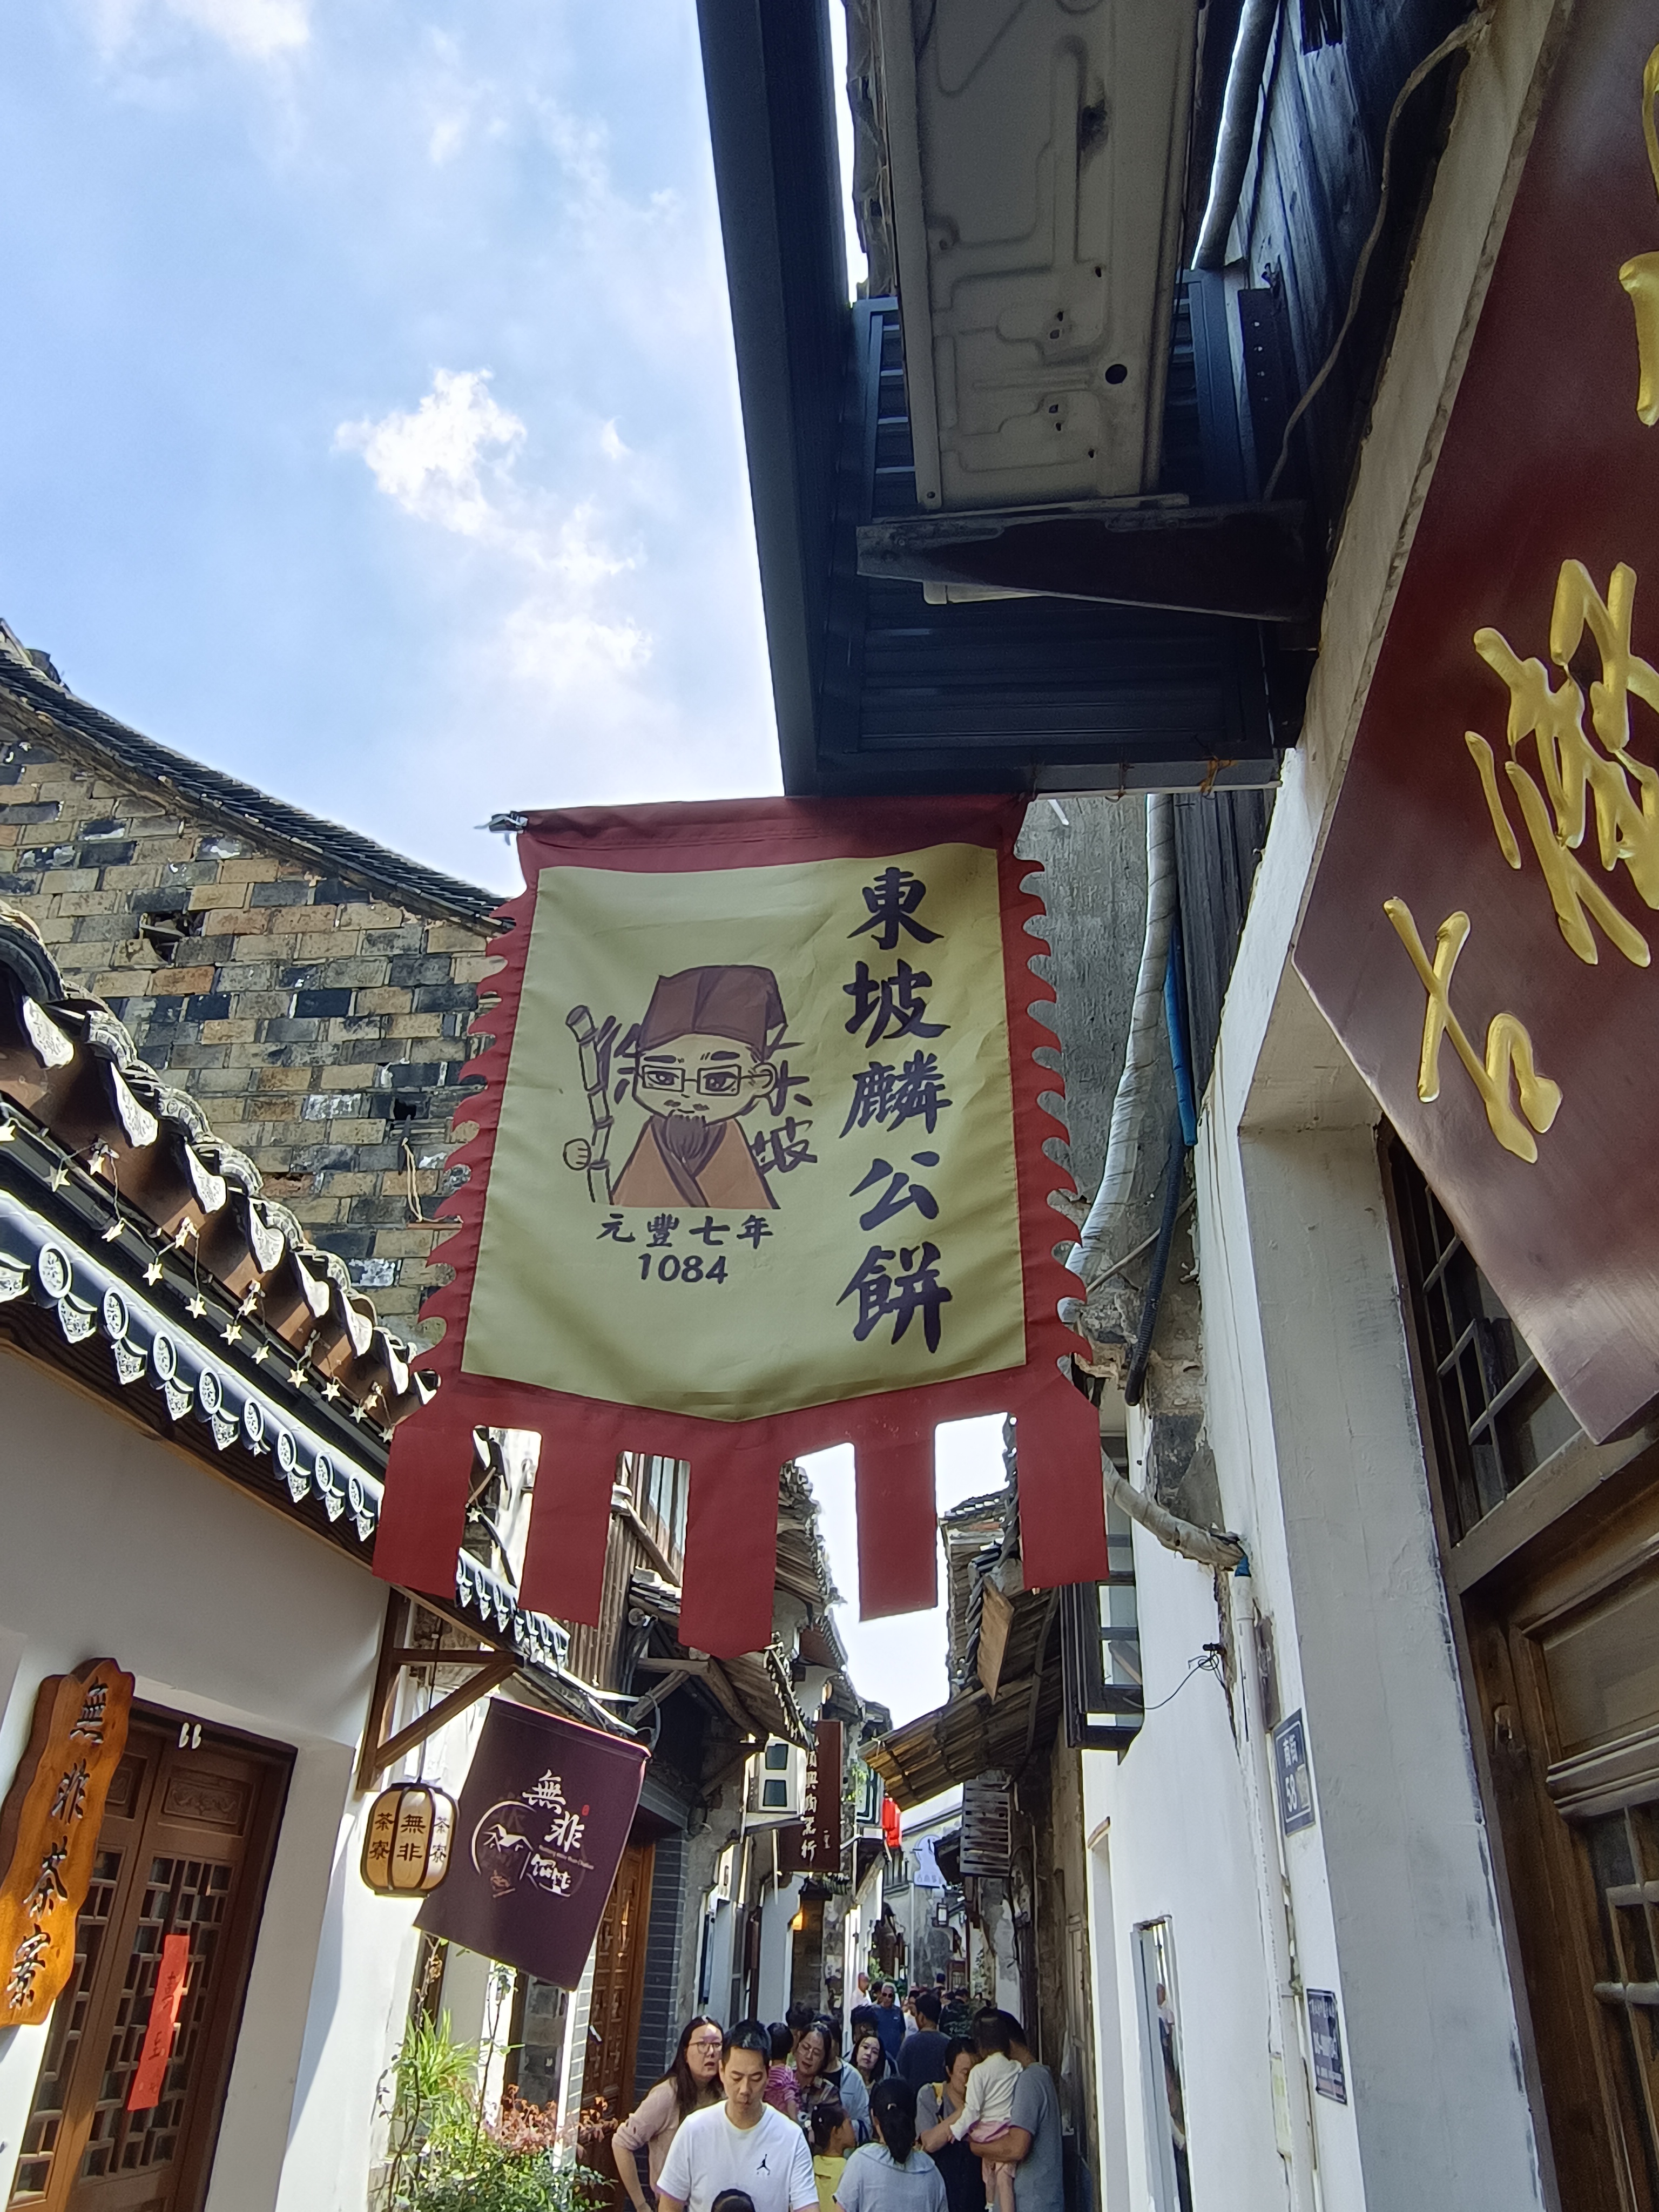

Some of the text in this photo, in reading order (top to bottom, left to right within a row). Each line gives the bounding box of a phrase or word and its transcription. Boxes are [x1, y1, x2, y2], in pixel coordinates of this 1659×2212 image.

[596, 1213, 774, 1248] 元豐七年
[638, 1253, 729, 1284] 1084
[396, 1814, 426, 1862] 無非
